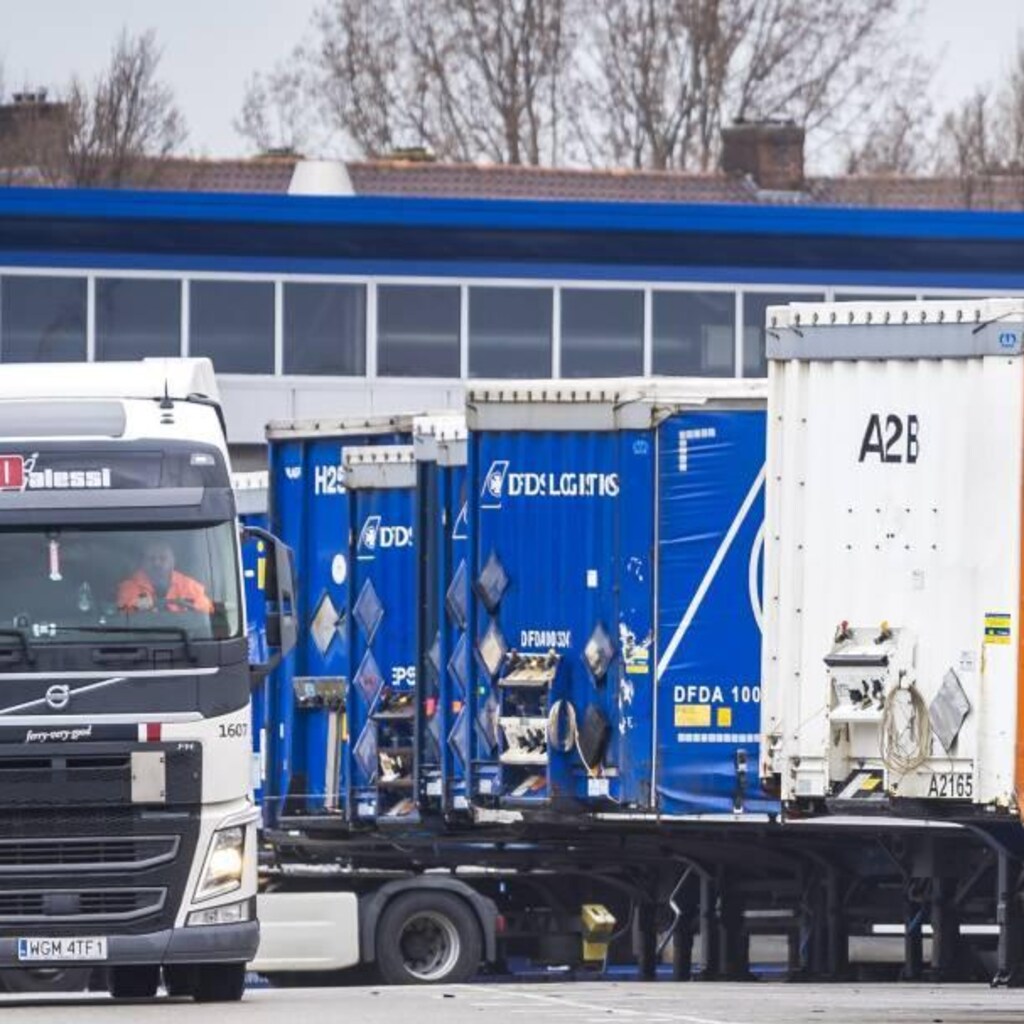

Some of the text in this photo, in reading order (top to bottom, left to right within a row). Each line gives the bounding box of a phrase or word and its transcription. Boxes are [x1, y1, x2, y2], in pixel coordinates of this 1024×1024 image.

[859, 413, 920, 463] A2B
[508, 473, 546, 496] DDS
[674, 685, 724, 703] DFDA
[928, 772, 973, 797] A2165
[30, 940, 62, 955] WGM
